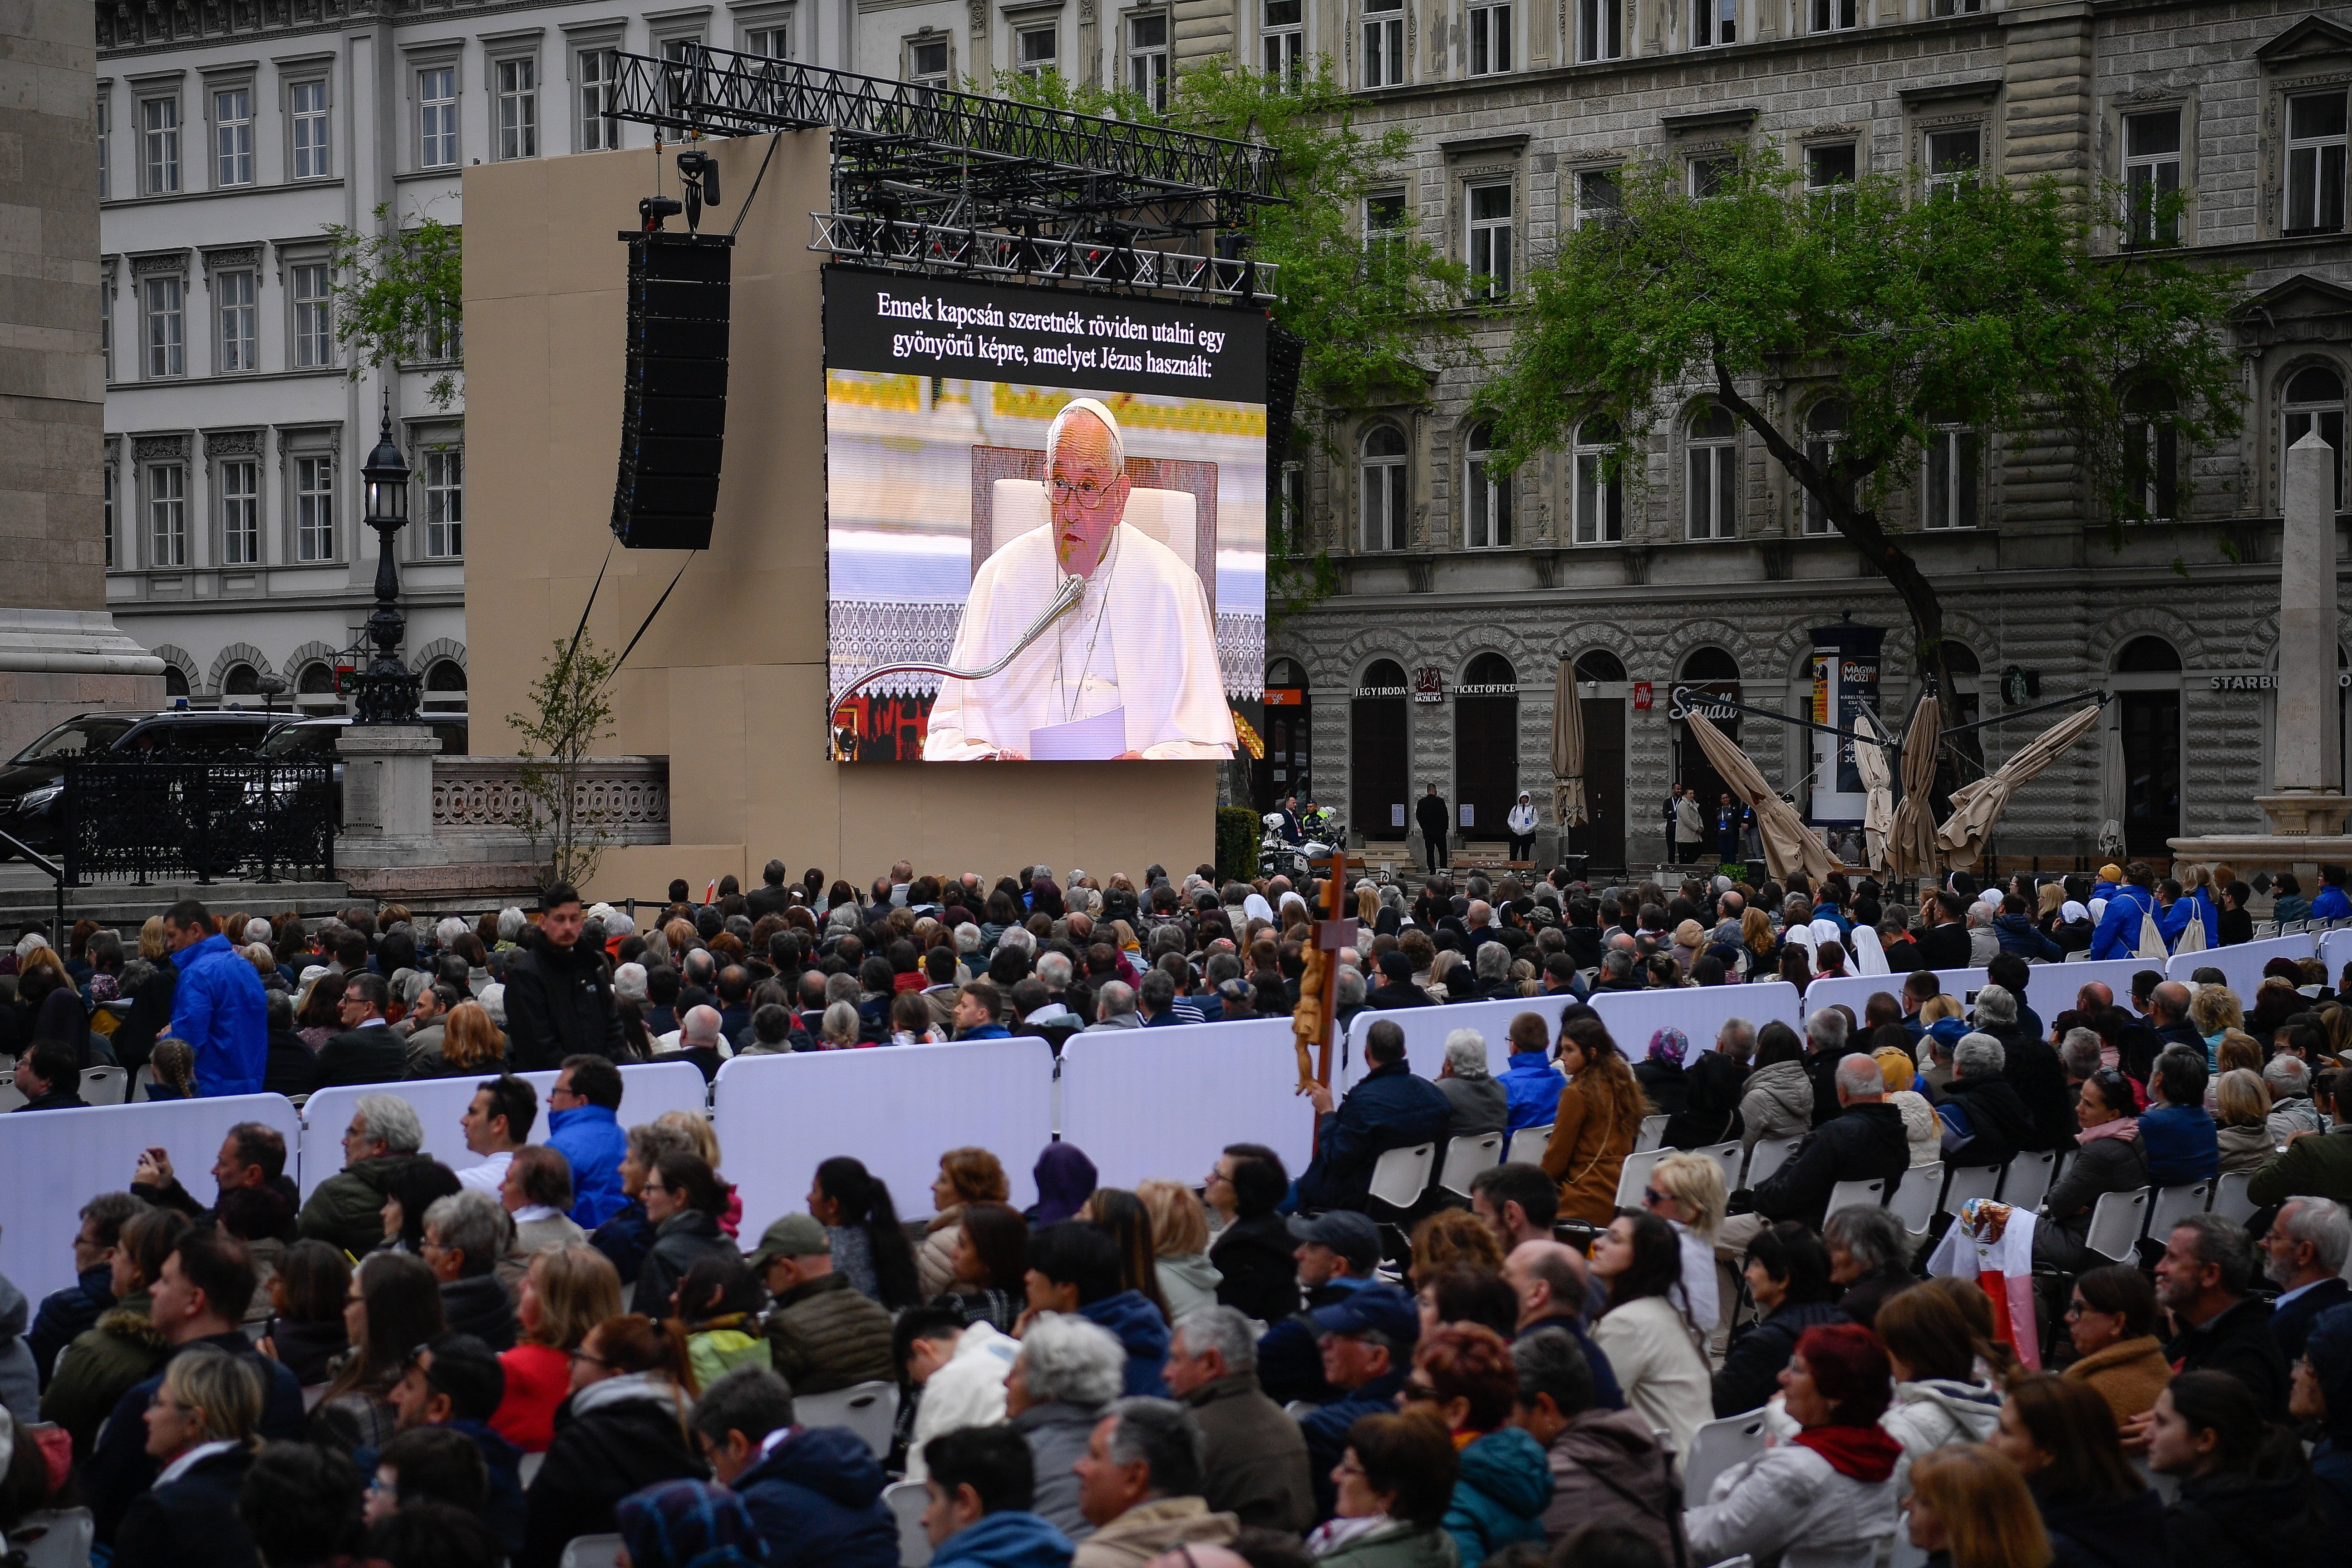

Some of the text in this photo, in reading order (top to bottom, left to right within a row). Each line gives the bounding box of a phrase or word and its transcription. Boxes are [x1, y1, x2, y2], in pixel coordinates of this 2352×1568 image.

[877, 292, 1225, 353] Ennek kapcsán szeretnék röviden utalni egy
[893, 330, 1212, 378] gyönyörű képre, amelyet Jézus használt:
[1844, 665, 1877, 674] MAGYAR
[1843, 673, 1869, 683] MOZI
[2211, 676, 2278, 689] STARBU
[1355, 687, 1407, 697] JEGYIRODA
[1453, 683, 1515, 694] TICKET OFFICE
[1636, 686, 1651, 707] illy
